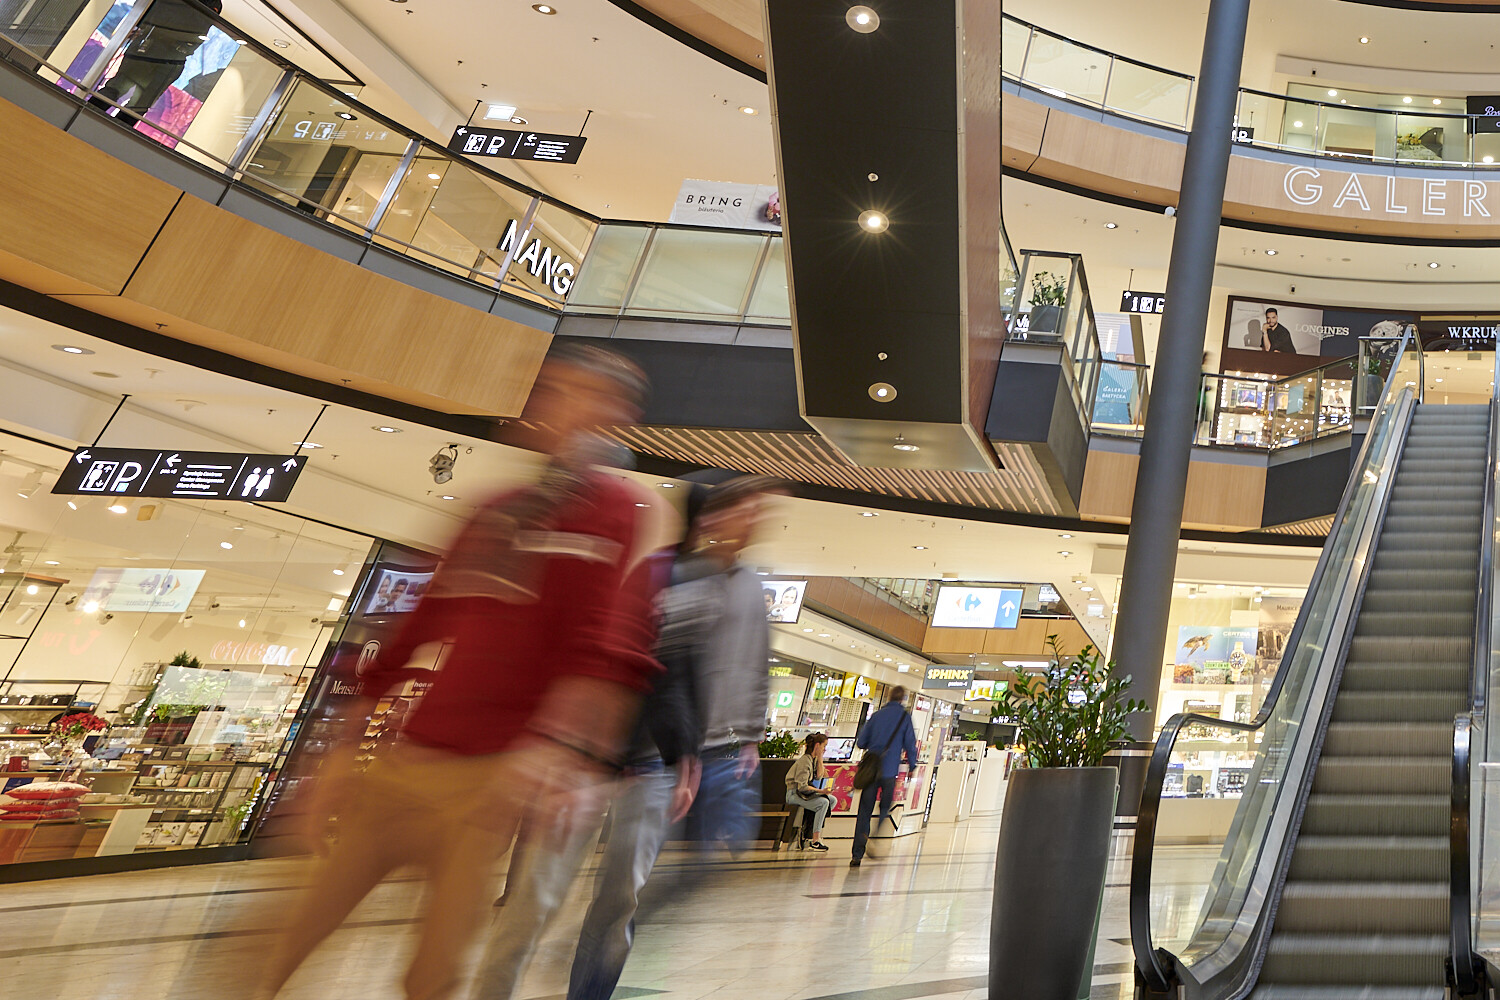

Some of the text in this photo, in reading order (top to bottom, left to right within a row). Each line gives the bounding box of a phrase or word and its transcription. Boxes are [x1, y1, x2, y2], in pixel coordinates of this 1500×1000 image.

[685, 194, 744, 208] BRING
[498, 218, 575, 297] MANG
[1294, 323, 1350, 337] LONGINES
[927, 668, 969, 680] SPHINX
[329, 680, 355, 695] Mensa
